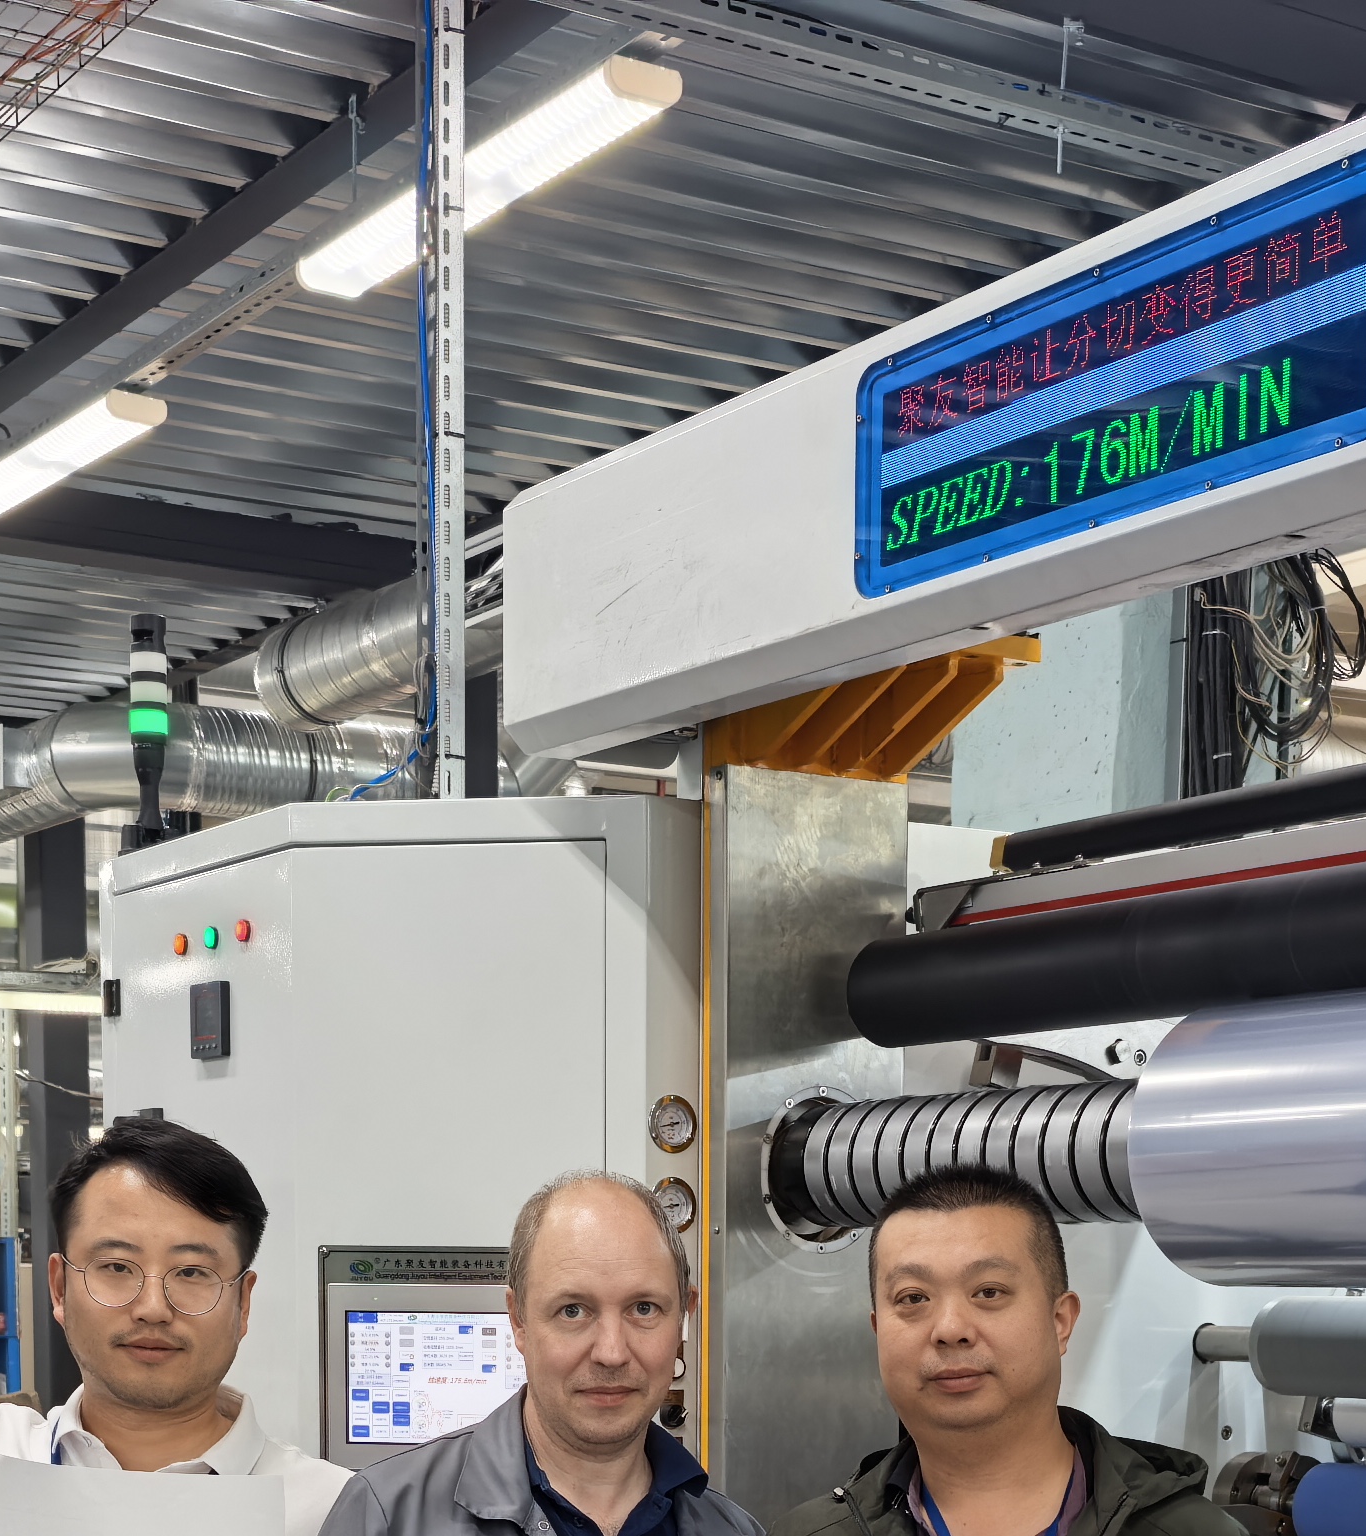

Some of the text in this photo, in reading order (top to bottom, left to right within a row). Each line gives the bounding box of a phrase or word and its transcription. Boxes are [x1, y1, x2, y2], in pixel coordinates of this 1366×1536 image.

[897, 211, 1348, 437] 聚友智能让分切变得更简单
